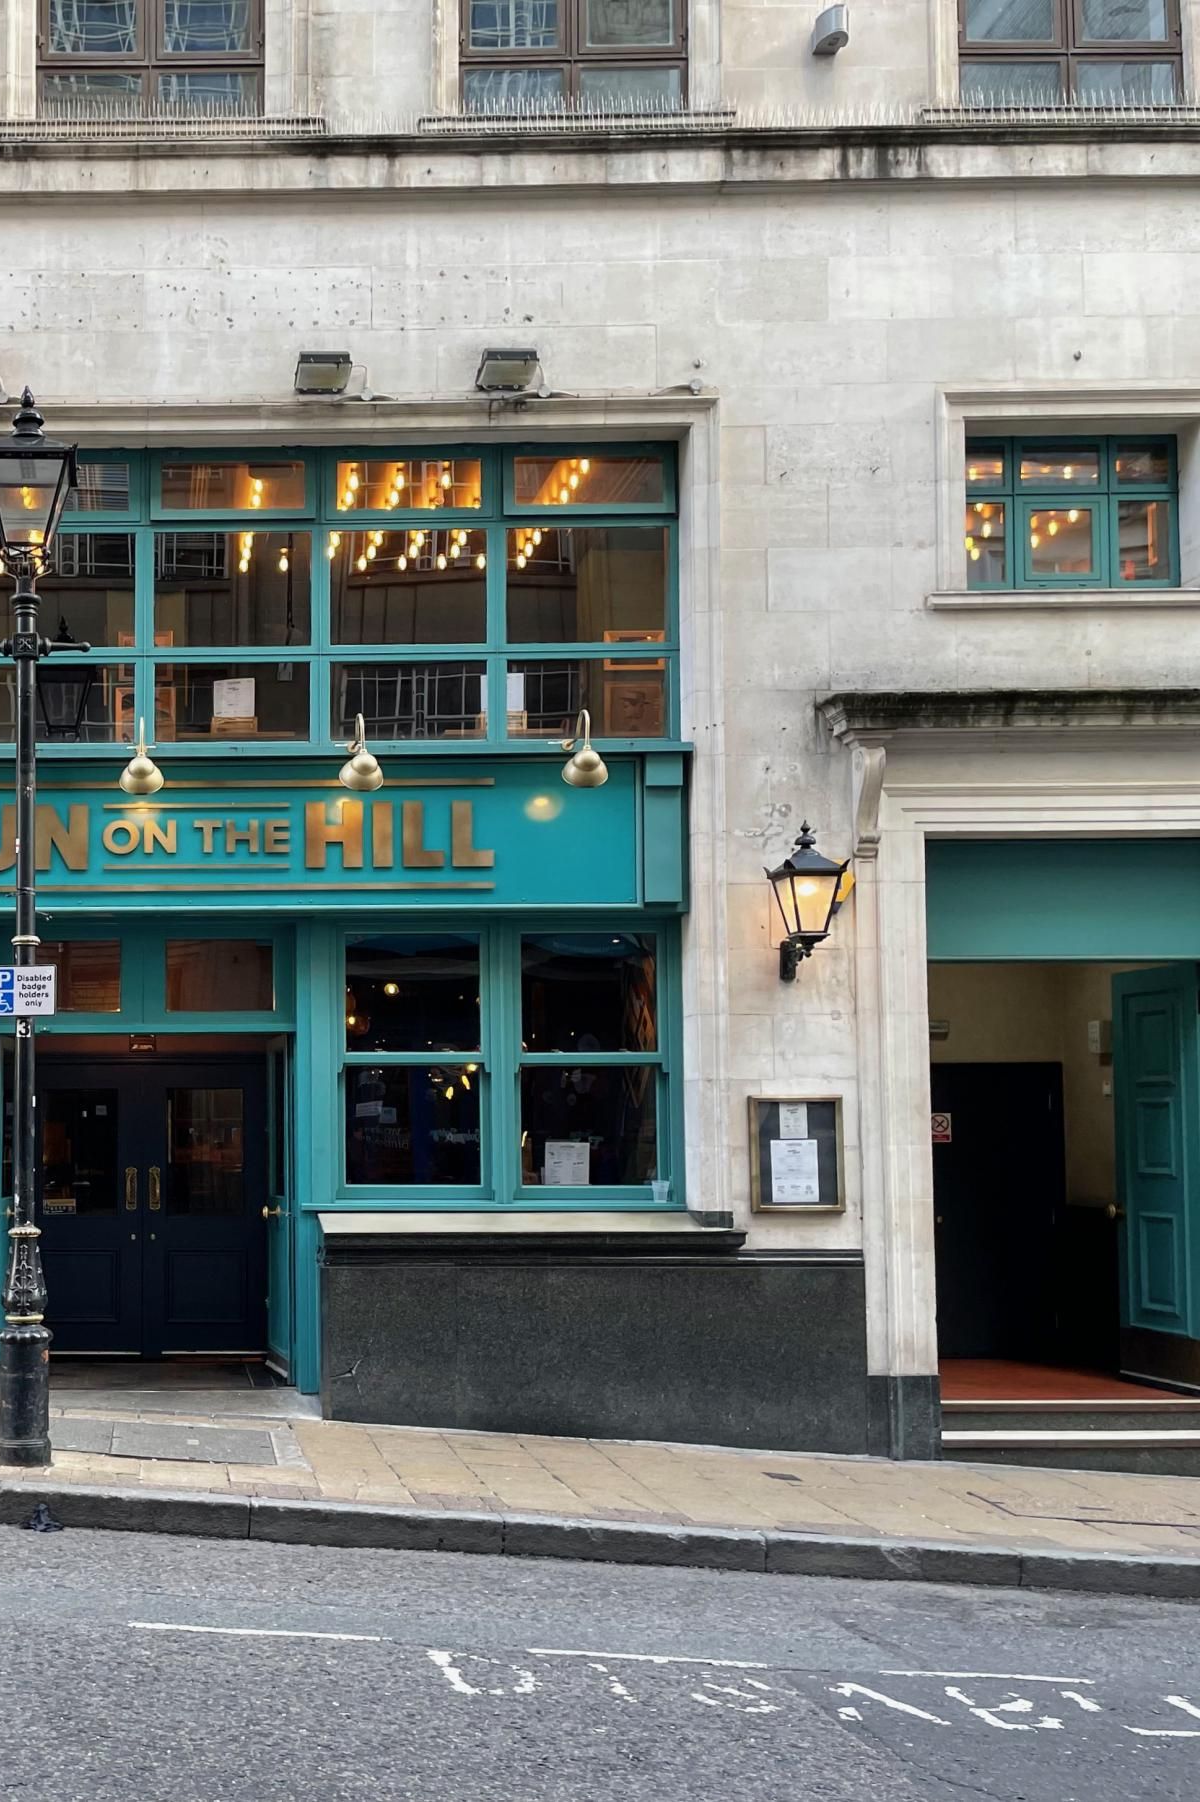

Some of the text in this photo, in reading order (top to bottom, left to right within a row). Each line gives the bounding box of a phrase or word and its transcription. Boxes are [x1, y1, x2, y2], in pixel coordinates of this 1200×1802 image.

[102, 819, 177, 855] ON
[193, 819, 290, 854] THE
[305, 800, 495, 869] HILL
[17, 974, 52, 982] Disabled
[18, 1019, 30, 1036] 3
